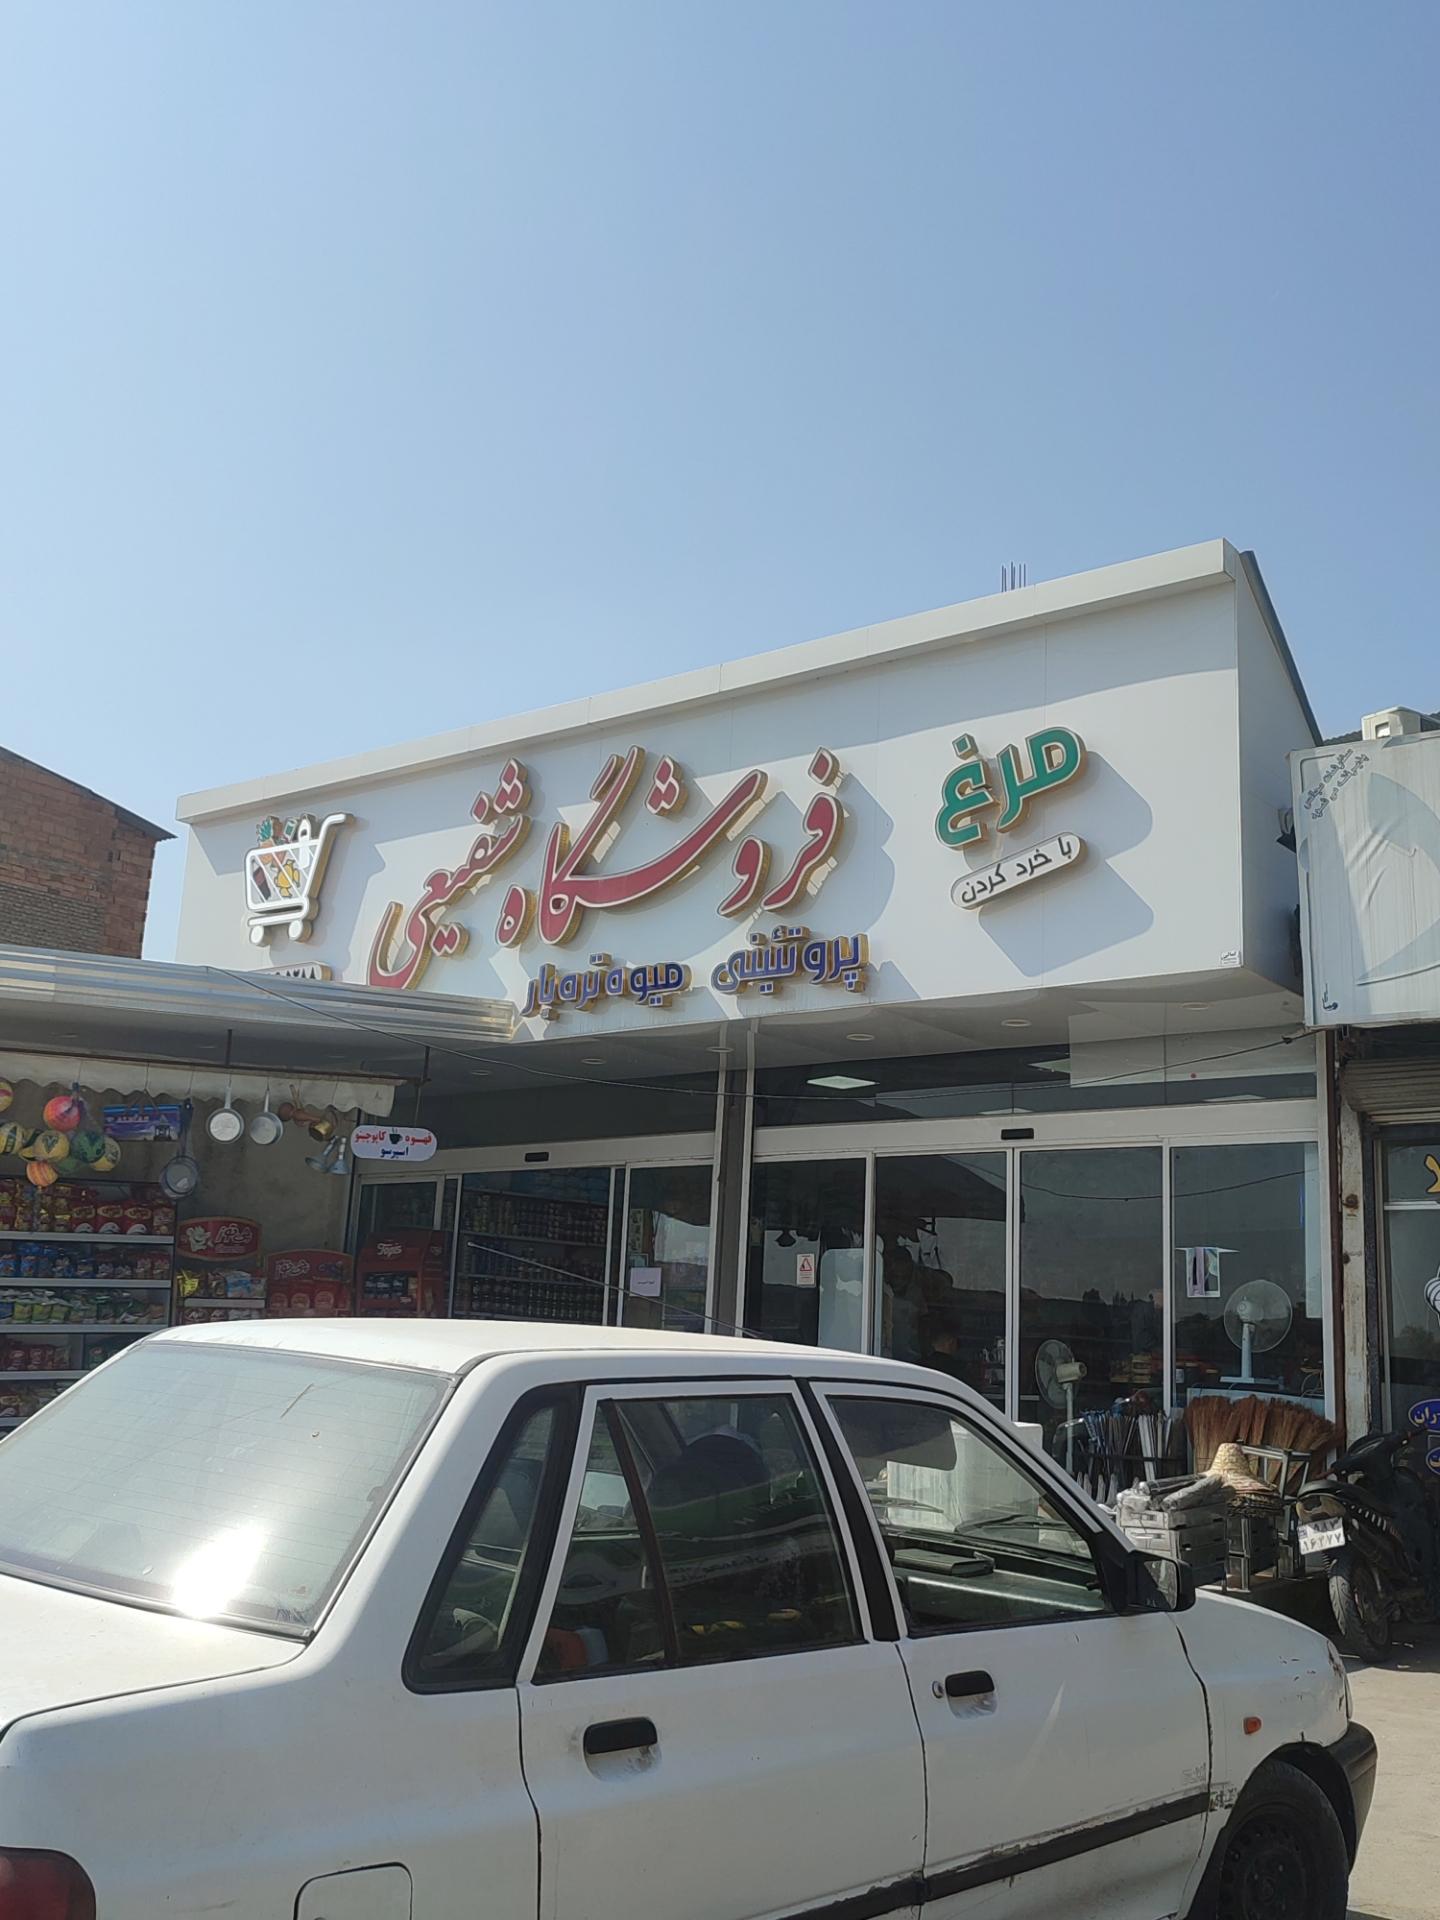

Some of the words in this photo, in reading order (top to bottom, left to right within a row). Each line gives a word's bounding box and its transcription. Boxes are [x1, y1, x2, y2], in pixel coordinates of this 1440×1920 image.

[934, 726, 1088, 851] مرغ
[368, 757, 533, 991] شفیعی
[497, 745, 844, 948] فروشگاه
[1015, 848, 1053, 877] خرد
[1057, 836, 1073, 860] با
[961, 862, 1007, 903] کردن
[558, 952, 611, 1012] تره
[605, 961, 691, 1008] میوه
[711, 925, 869, 993] پروتئینی
[519, 962, 559, 1020] بار
[404, 1132, 433, 1146] قهوه
